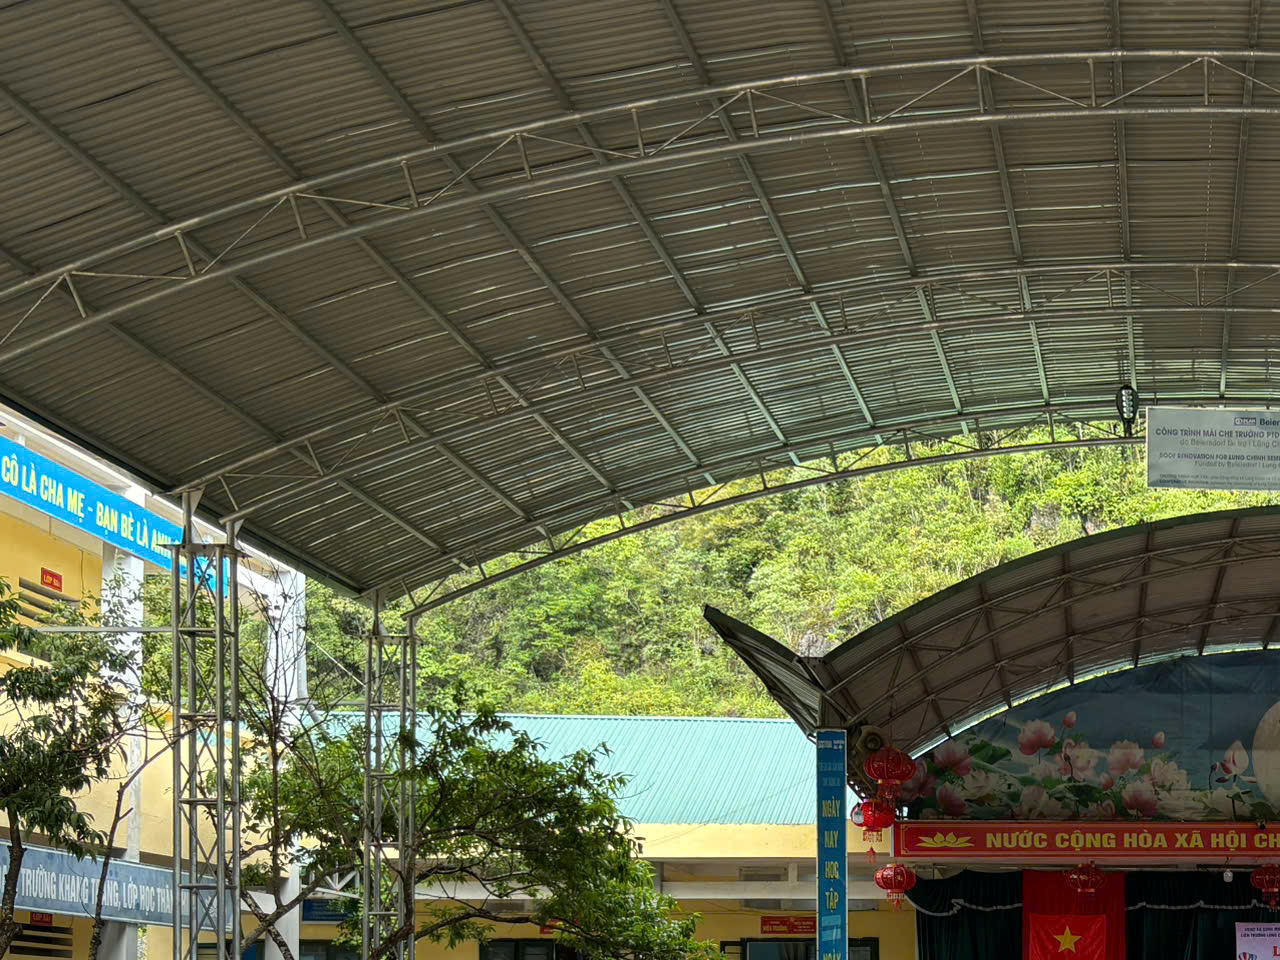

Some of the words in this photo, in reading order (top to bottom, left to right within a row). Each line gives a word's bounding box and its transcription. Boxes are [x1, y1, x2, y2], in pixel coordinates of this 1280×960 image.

[1, 454, 19, 487] CÔ
[21, 462, 37, 497] LÀ
[40, 475, 65, 508] CHA
[67, 488, 85, 523] MẸ
[96, 501, 119, 537] BẠN
[121, 511, 134, 542] BÈ
[136, 519, 150, 551] LÀ
[822, 795, 841, 817] NGÀY
[824, 830, 839, 848] NAY
[986, 831, 1048, 848] NƯỚC
[1055, 831, 1116, 852] CỘNG
[1123, 829, 1168, 848] HÒA
[1175, 830, 1204, 848] XÃ
[1210, 830, 1246, 852] HỘI
[824, 861, 840, 883] HỌC
[21, 864, 56, 900] TRƯỜNG
[58, 874, 88, 904] KHANG
[122, 876, 138, 911] LỚP
[140, 884, 156, 916] HỌC
[825, 887, 839, 913] TẬP
